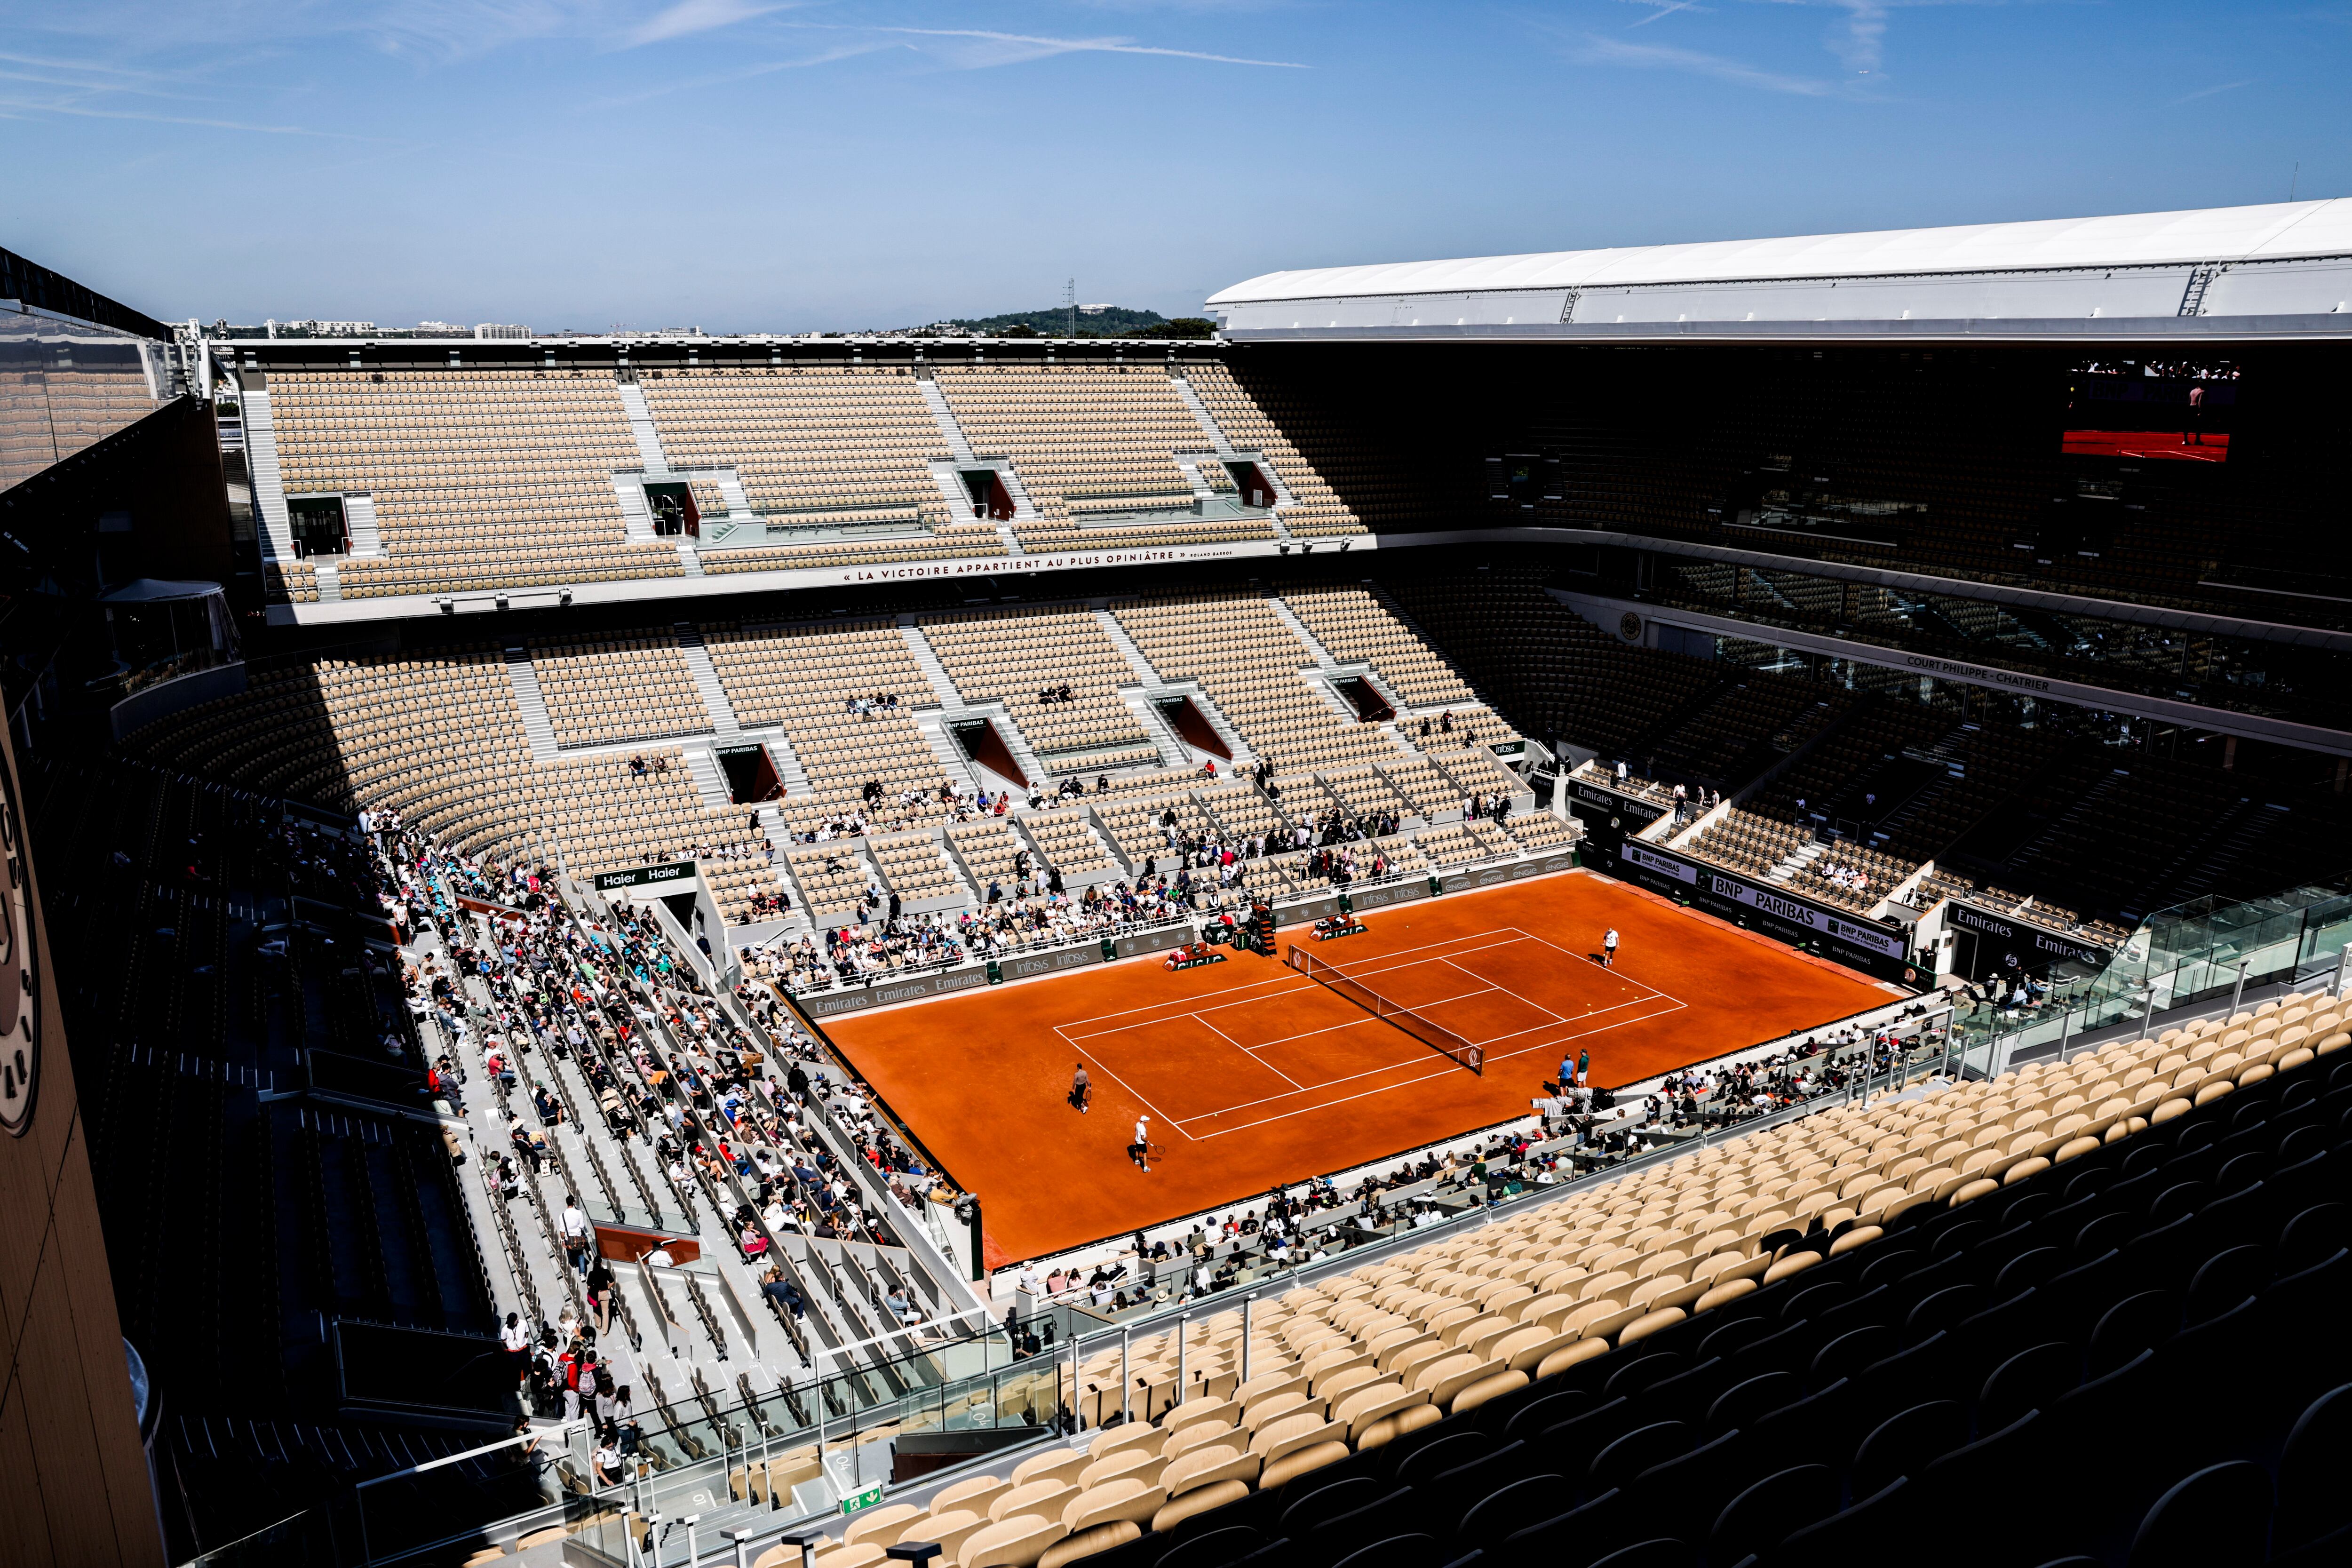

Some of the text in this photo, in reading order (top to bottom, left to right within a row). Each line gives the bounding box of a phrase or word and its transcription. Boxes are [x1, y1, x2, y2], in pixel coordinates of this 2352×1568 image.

[882, 566, 948, 578] VICTOIRE
[957, 560, 1040, 573] APPARTIENT
[1071, 557, 1099, 565] PLUS
[1107, 551, 1173, 563] OPINIÂTRE
[1907, 656, 1941, 669] COURT
[1942, 661, 1987, 678] PHILIPPE
[1996, 673, 2049, 690] CHATRIER
[1496, 744, 1515, 754] Infosys
[1534, 777, 1551, 788] Emirates
[1578, 786, 1613, 806] Emirates
[1624, 801, 1660, 820] Emirates
[1642, 853, 1679, 872] BNP PARIBAS
[604, 874, 636, 886] Haier
[649, 868, 679, 880] Haier
[1394, 886, 1419, 899] Infosys
[1650, 878, 1670, 890] PARIBAS
[1362, 892, 1388, 906] Infosys
[1699, 896, 1732, 913] BNP PARIBAS
[1716, 878, 1814, 925] BNP PARIBAS
[1763, 920, 1798, 938] BNP PARIBAS
[1958, 908, 2012, 938] Emirates
[1841, 924, 1889, 947] BNP PARIBAS
[1832, 946, 1871, 964] BNP PARIBAS
[2036, 934, 2096, 964] Emirates
[1017, 959, 1049, 974] Infosys
[1057, 952, 1088, 966] Infosys
[935, 972, 984, 991] Emirates
[876, 984, 926, 1002] Emirates
[816, 995, 867, 1013] Emirates
